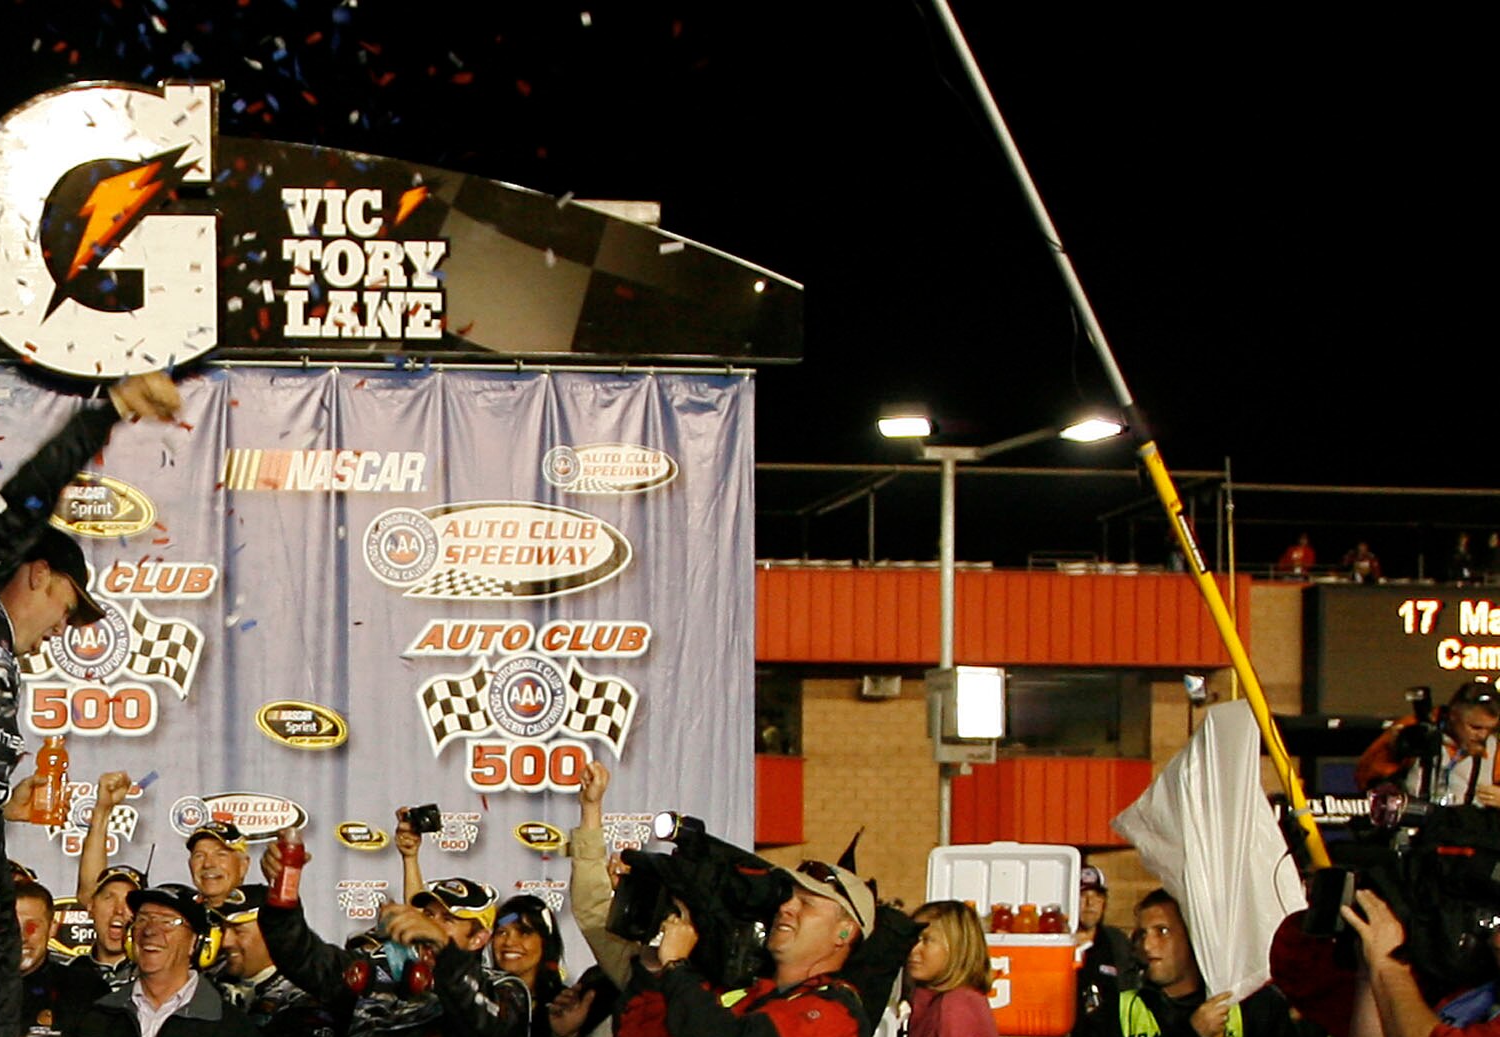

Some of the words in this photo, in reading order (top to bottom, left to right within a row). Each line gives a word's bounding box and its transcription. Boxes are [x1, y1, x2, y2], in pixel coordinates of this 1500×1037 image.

[282, 189, 382, 236] VIC
[282, 241, 446, 287] TORY
[283, 291, 442, 338] LANE
[582, 453, 621, 463] AUTO
[625, 453, 661, 463] CLUB
[286, 451, 427, 491] NASCAR
[70, 501, 113, 517] Sprint
[442, 519, 519, 539] AUTO
[529, 520, 598, 540] CLUB
[444, 545, 596, 566] SPEEDWAY
[104, 566, 213, 593] CLUB
[1398, 600, 1439, 634] 17
[71, 626, 108, 650] AAA
[417, 624, 531, 651] AUTO
[540, 625, 650, 652] CLUB
[510, 684, 545, 706] AAA
[30, 688, 152, 729] 500
[471, 744, 587, 786] 500
[252, 801, 290, 812] CLUB
[65, 836, 116, 851] 50
[441, 840, 467, 850] 500
[348, 907, 375, 917] 500
